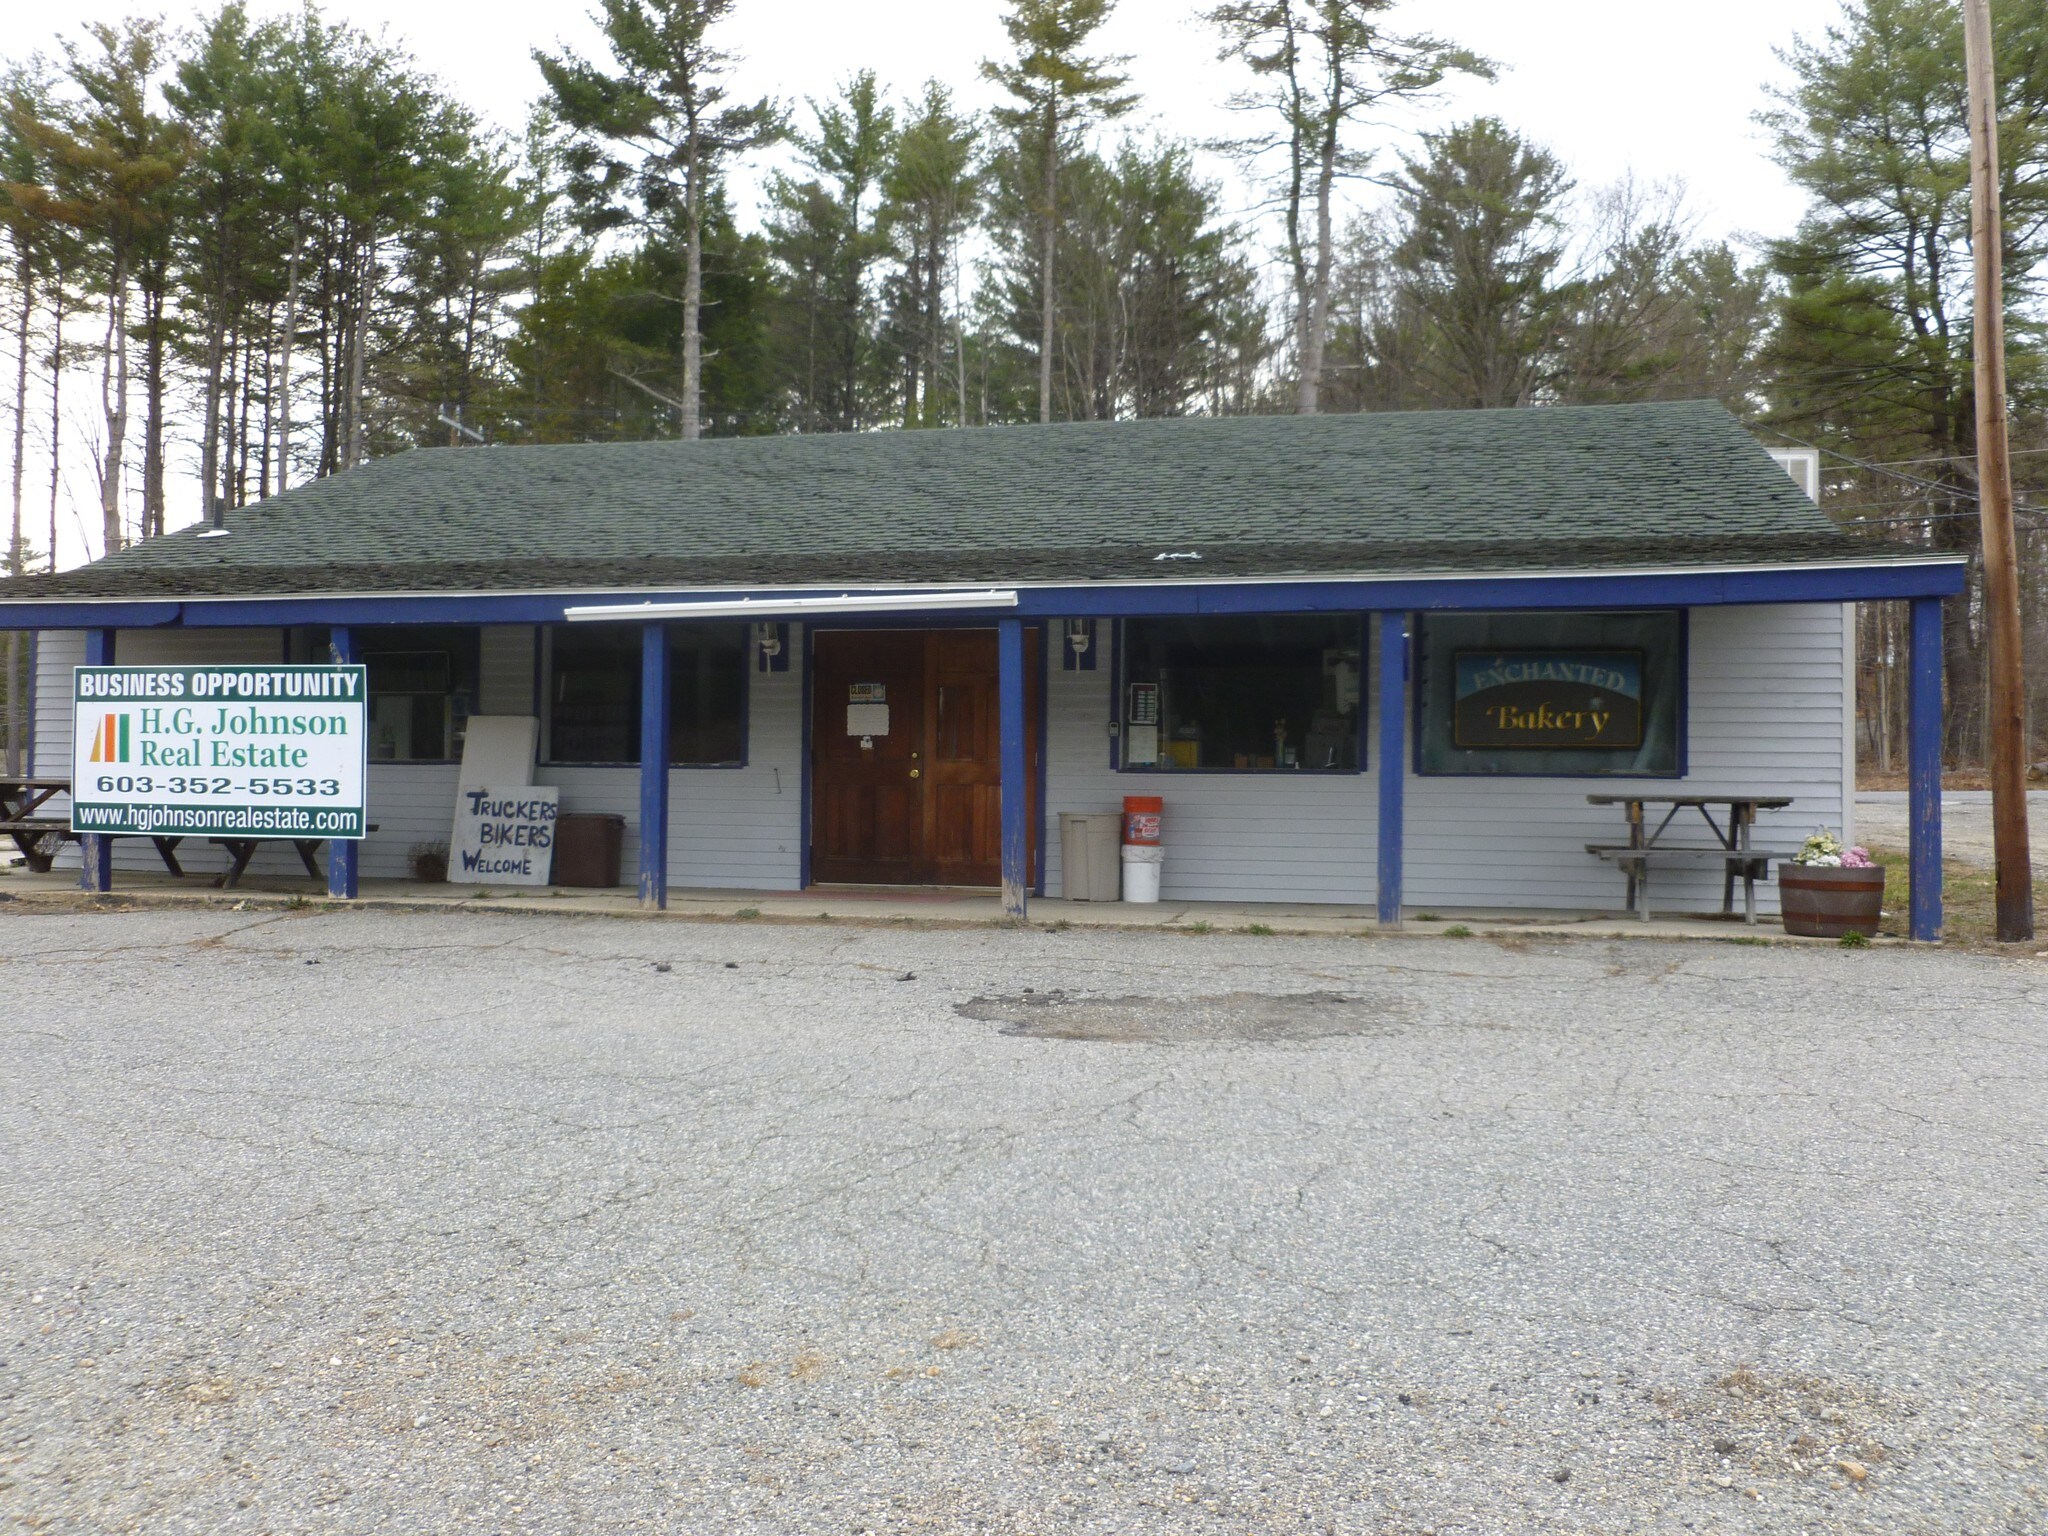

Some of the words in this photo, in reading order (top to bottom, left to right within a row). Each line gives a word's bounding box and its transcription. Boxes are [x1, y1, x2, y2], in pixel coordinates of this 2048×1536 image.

[81, 673, 184, 697] BUSINESS
[192, 672, 358, 697] OPPORTUNITY
[1473, 660, 1627, 692] ENCHANTED
[140, 708, 203, 735] H.G.
[211, 706, 348, 735] Johnson
[1486, 701, 1610, 740] Bakery
[140, 739, 201, 766] Real
[211, 740, 308, 767] Estate
[97, 776, 340, 796] 603-352-5533
[79, 804, 357, 831] www.hgjohnsonrealestate.com
[466, 791, 557, 821] TRUCKERS
[480, 823, 551, 848] BIKERS
[462, 849, 532, 875] WELCOME
